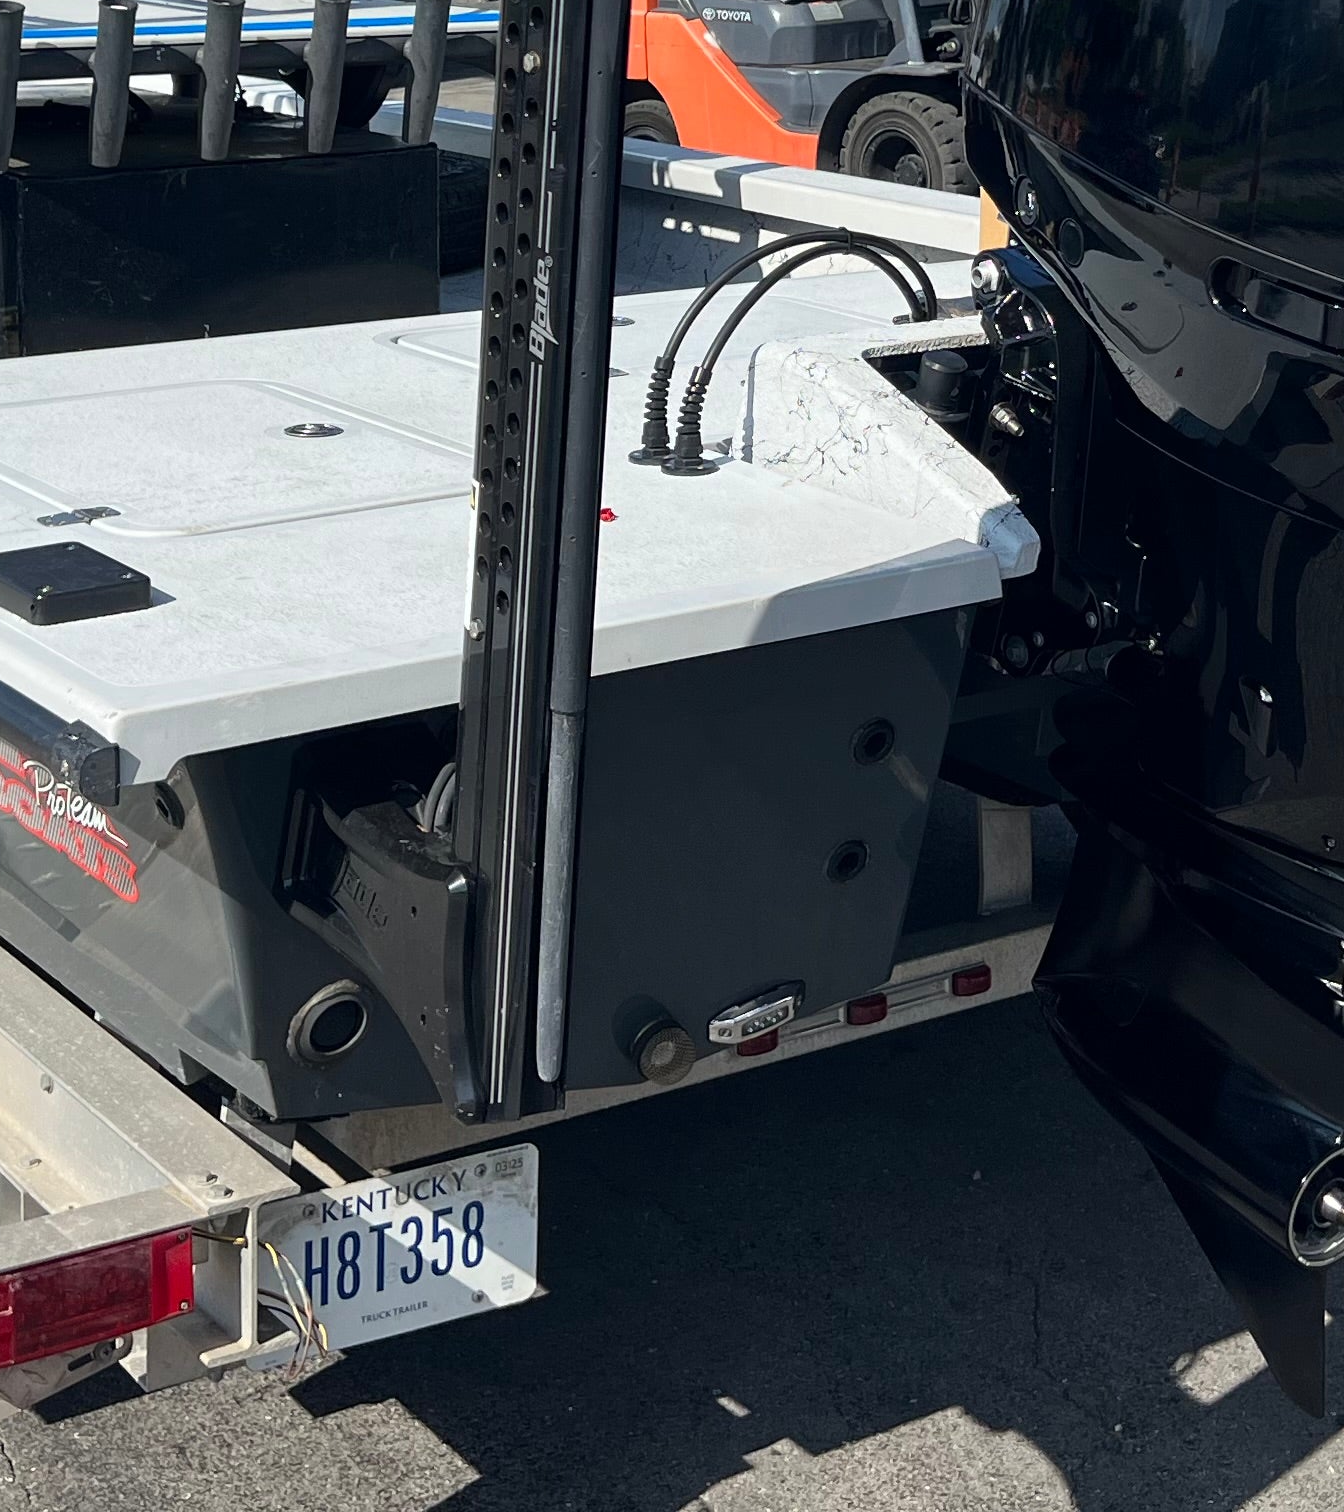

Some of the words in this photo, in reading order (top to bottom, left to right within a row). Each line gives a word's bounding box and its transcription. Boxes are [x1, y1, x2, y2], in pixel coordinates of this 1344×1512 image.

[716, 8, 751, 22] TOYOTA
[529, 258, 559, 361] Blade
[321, 1169, 467, 1224] KENTUCKY
[304, 1200, 485, 1307] H8T358
[361, 1311, 392, 1324] TRUCK
[393, 1301, 428, 1317] TRAILER
